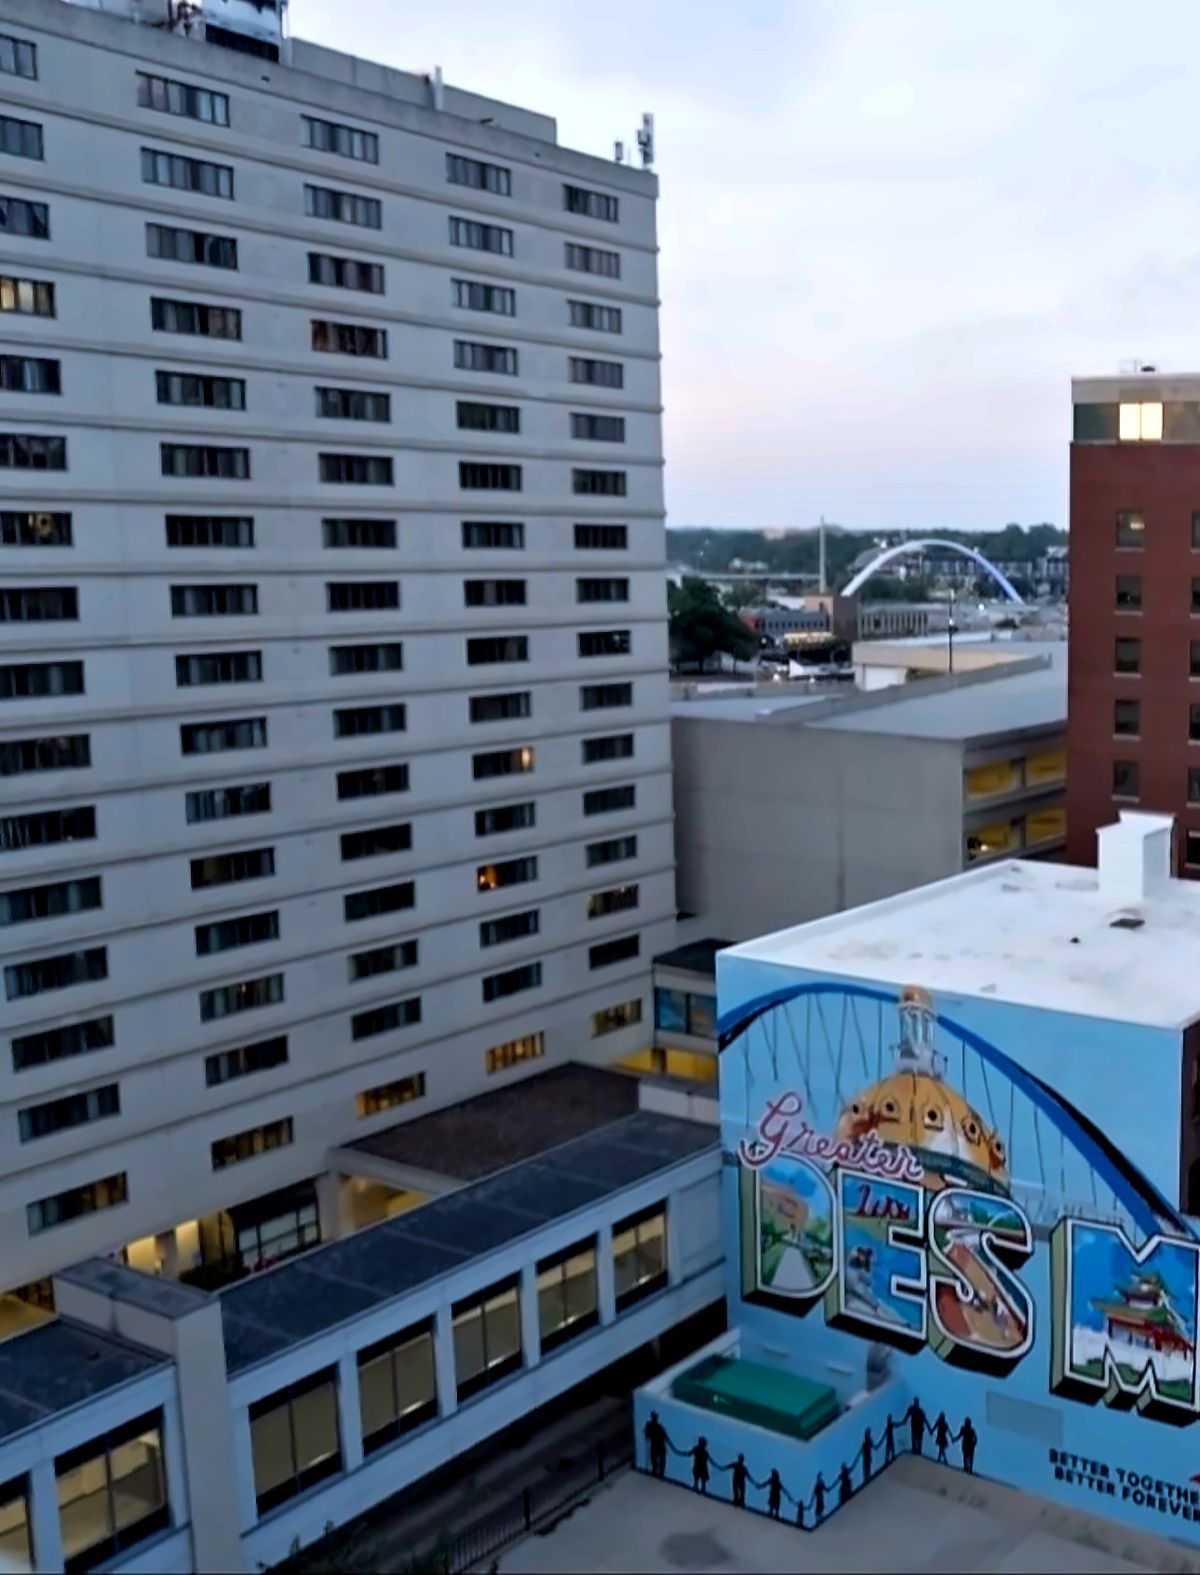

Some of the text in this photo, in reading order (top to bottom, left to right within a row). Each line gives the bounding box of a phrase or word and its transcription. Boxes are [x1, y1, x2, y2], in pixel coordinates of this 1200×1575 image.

[739, 1090, 924, 1179] Greater
[739, 1150, 1034, 1377] DES
[1049, 1448, 1110, 1478] BETTER
[1055, 1466, 1115, 1496] BETTER
